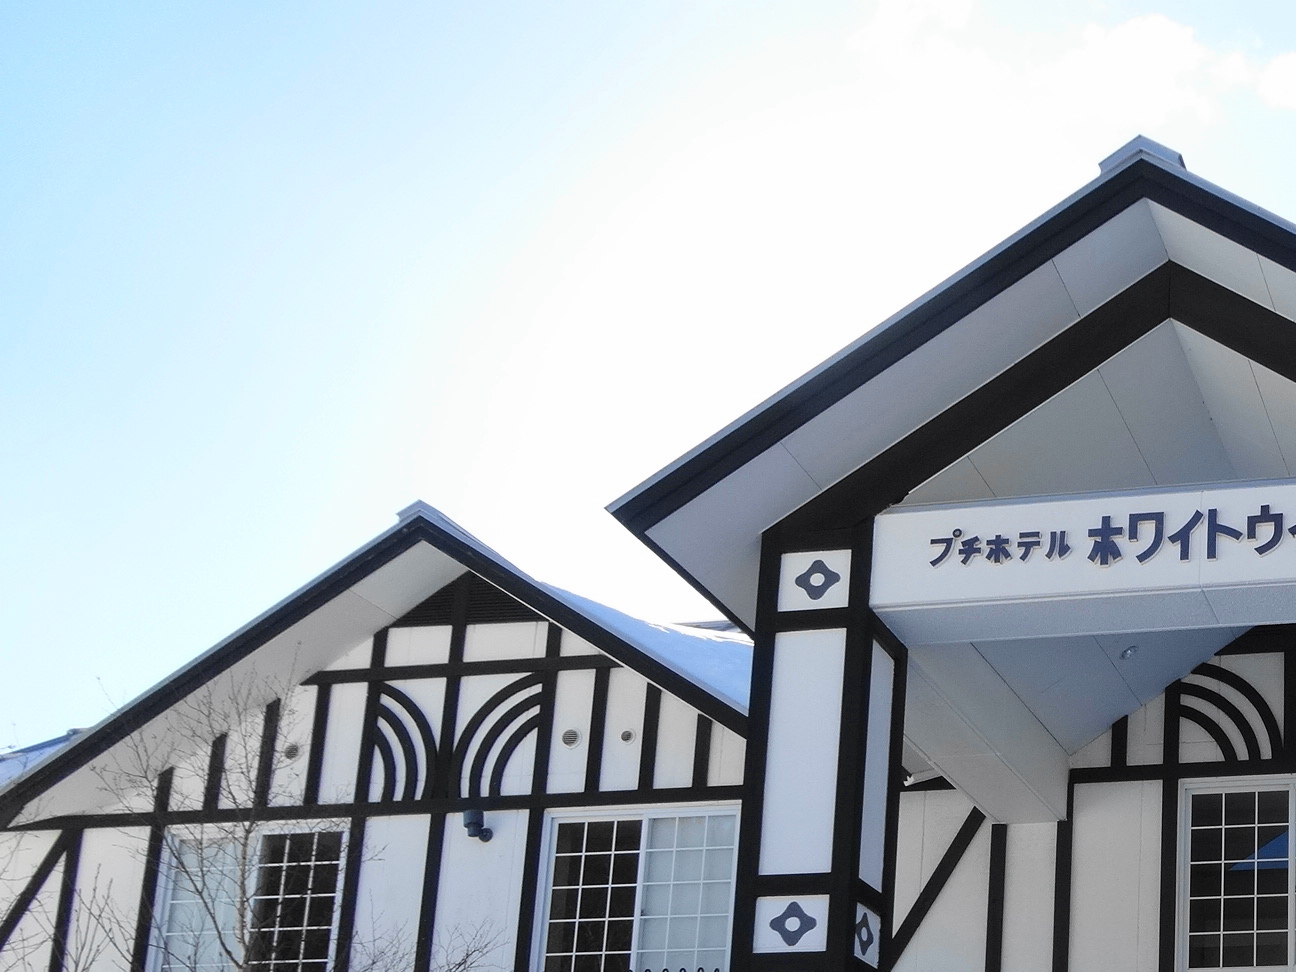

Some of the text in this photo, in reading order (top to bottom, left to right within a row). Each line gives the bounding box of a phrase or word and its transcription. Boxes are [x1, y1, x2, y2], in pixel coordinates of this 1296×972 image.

[929, 527, 1071, 568] プチホテル
